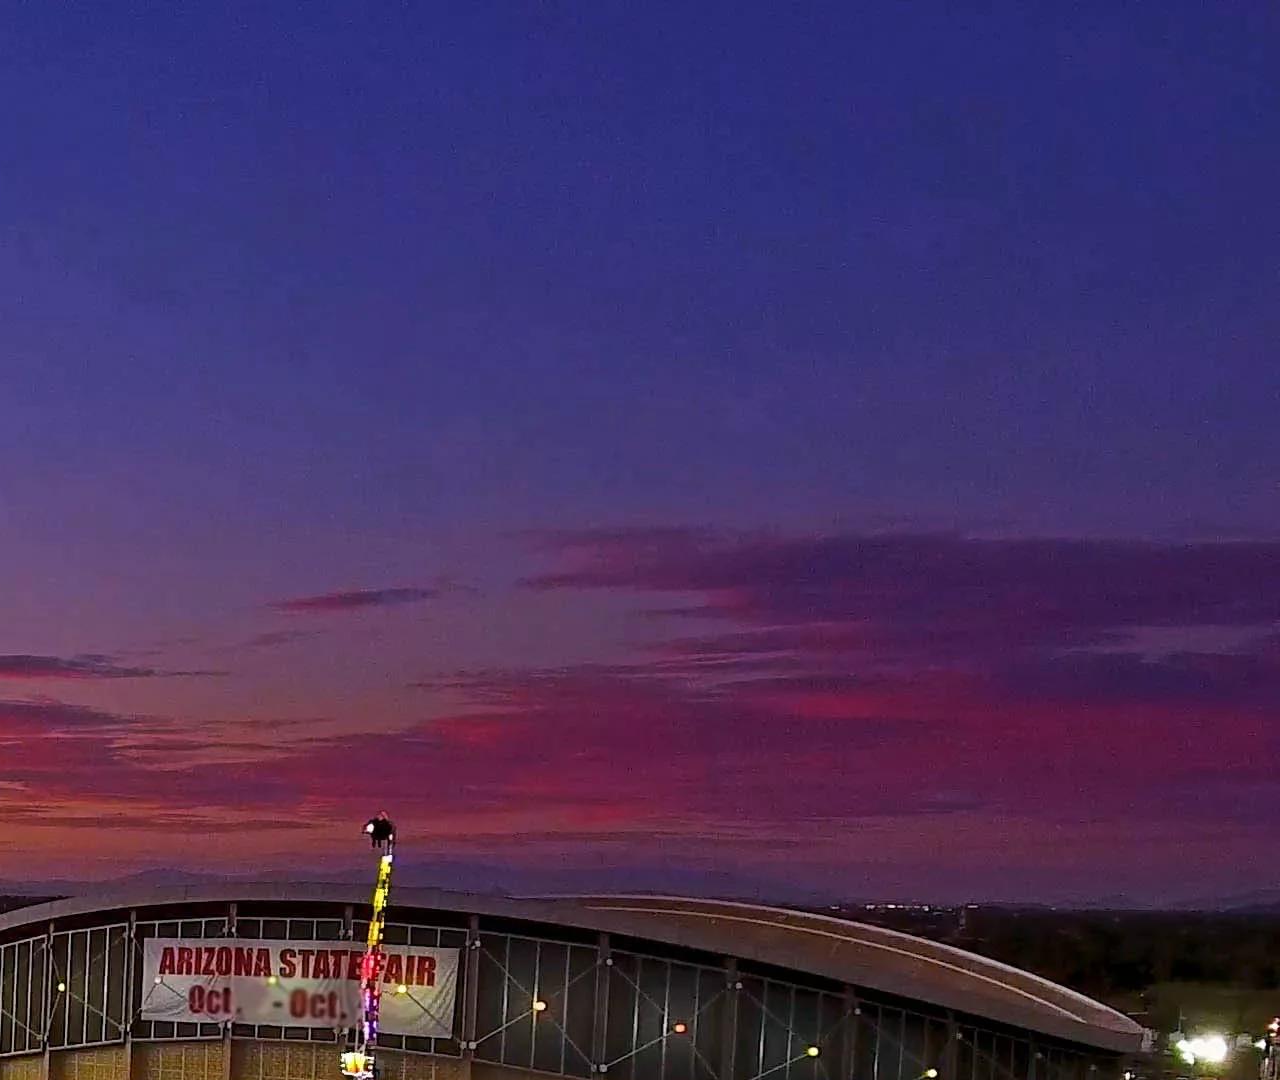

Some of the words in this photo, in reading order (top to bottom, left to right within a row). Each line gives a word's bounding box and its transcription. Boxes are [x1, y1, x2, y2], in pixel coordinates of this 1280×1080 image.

[159, 946, 273, 977] ARIZONA
[279, 949, 368, 981] STATE
[376, 952, 437, 987] FAIR
[289, 988, 346, 1020] Oct.
